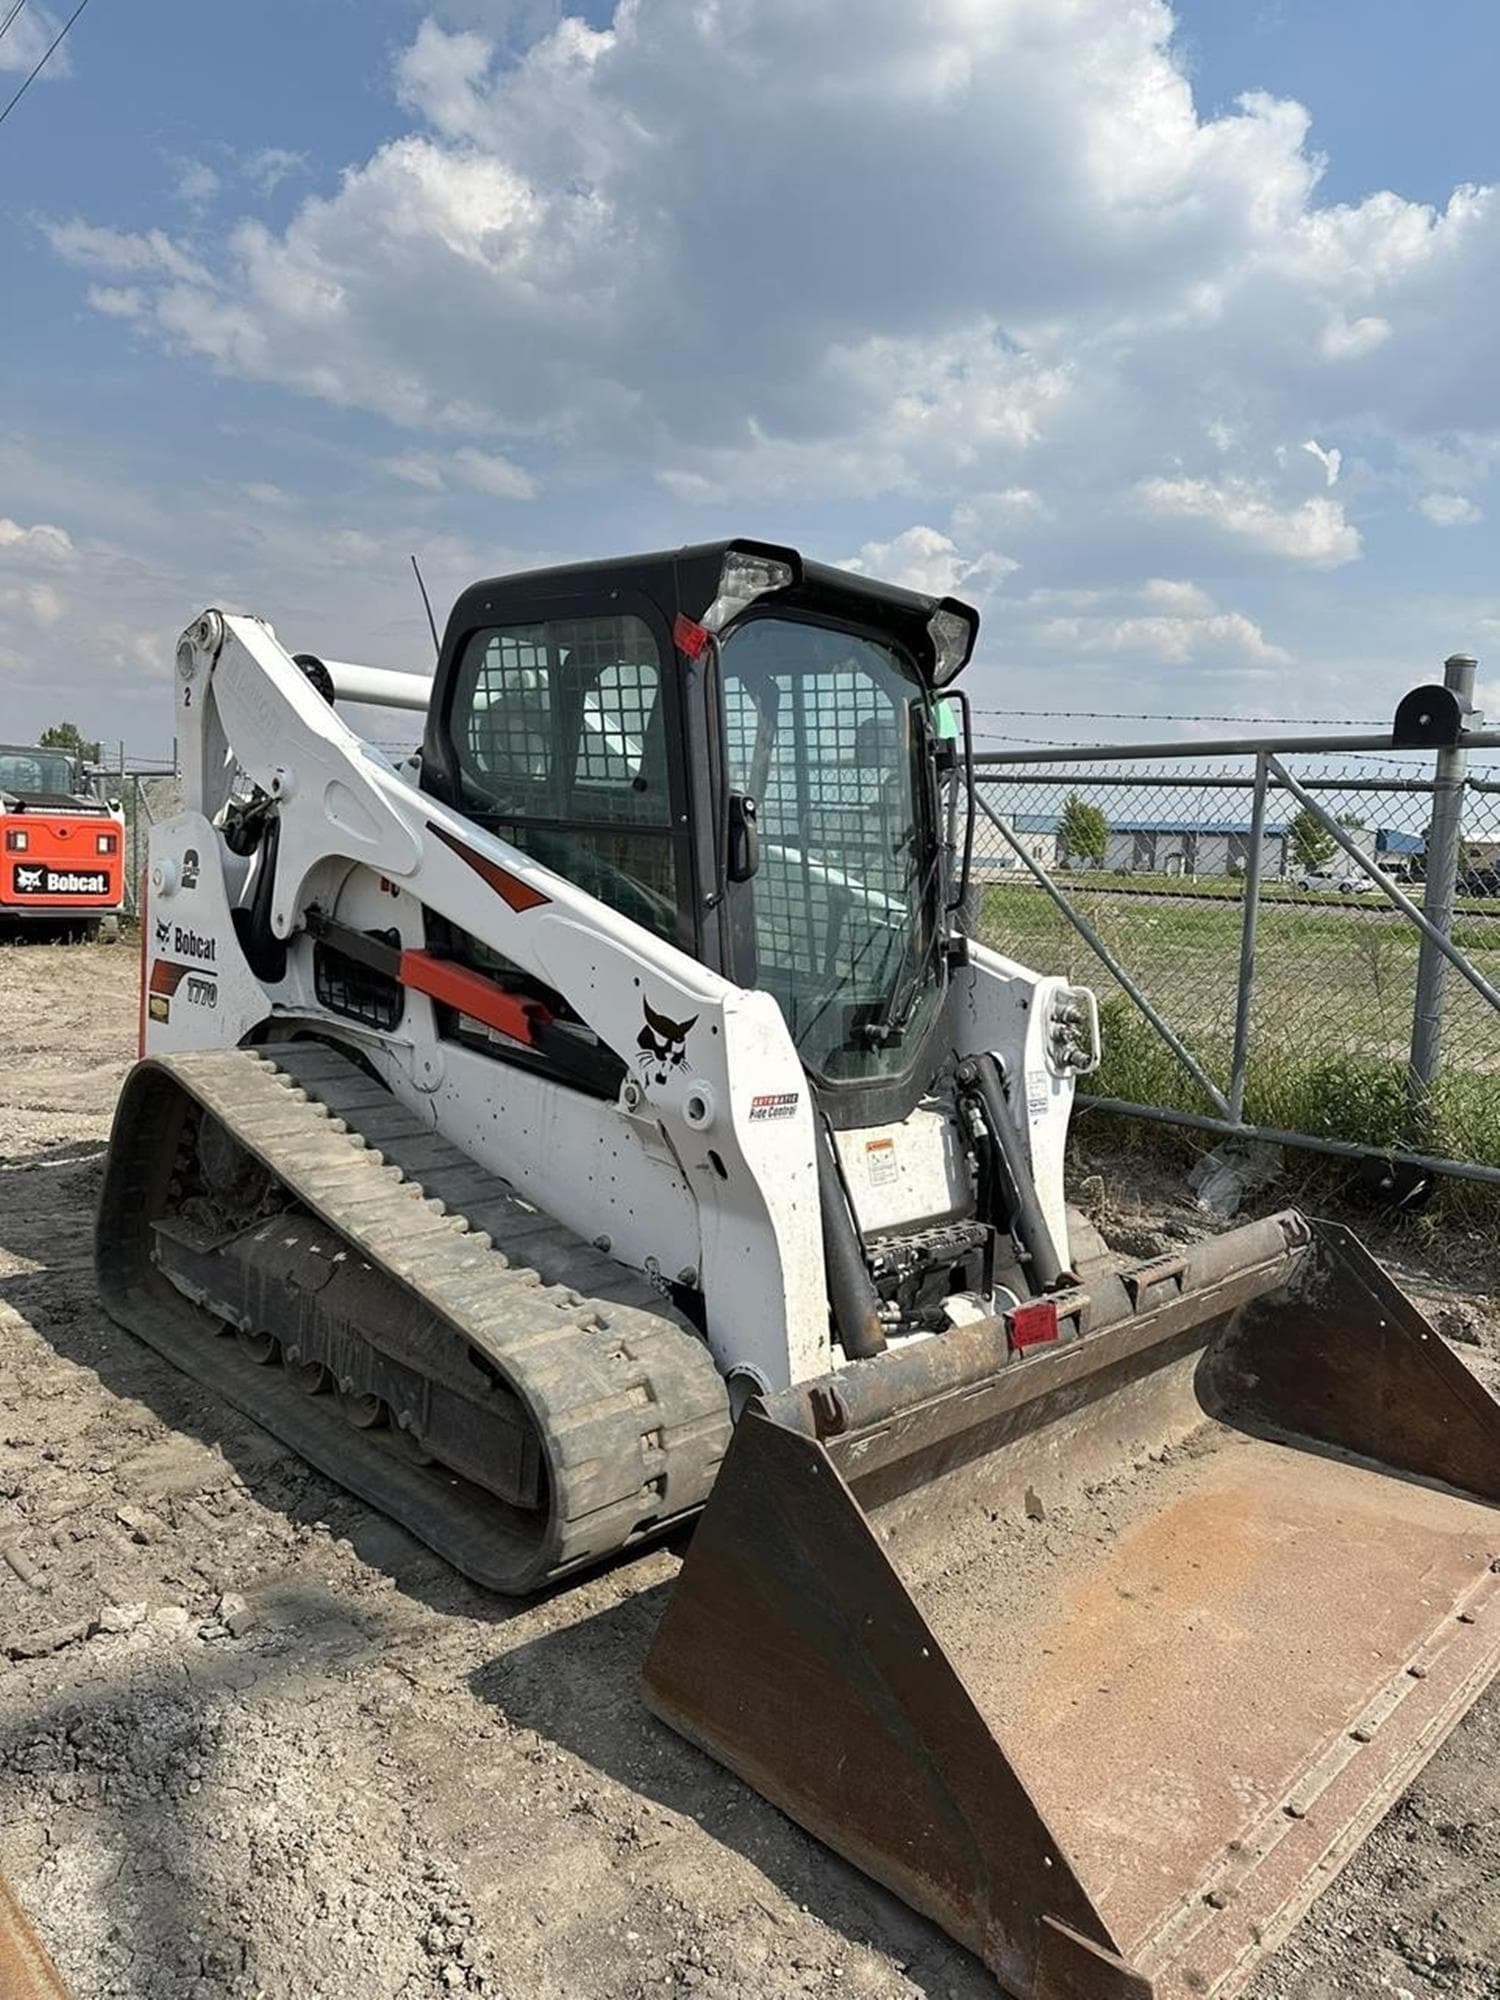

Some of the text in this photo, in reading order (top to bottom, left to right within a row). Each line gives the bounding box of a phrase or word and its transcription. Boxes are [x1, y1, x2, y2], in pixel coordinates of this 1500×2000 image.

[184, 686, 191, 707] 2
[47, 873, 104, 892] Bobcat
[175, 927, 216, 961] Bobcat
[187, 977, 218, 1009] T770
